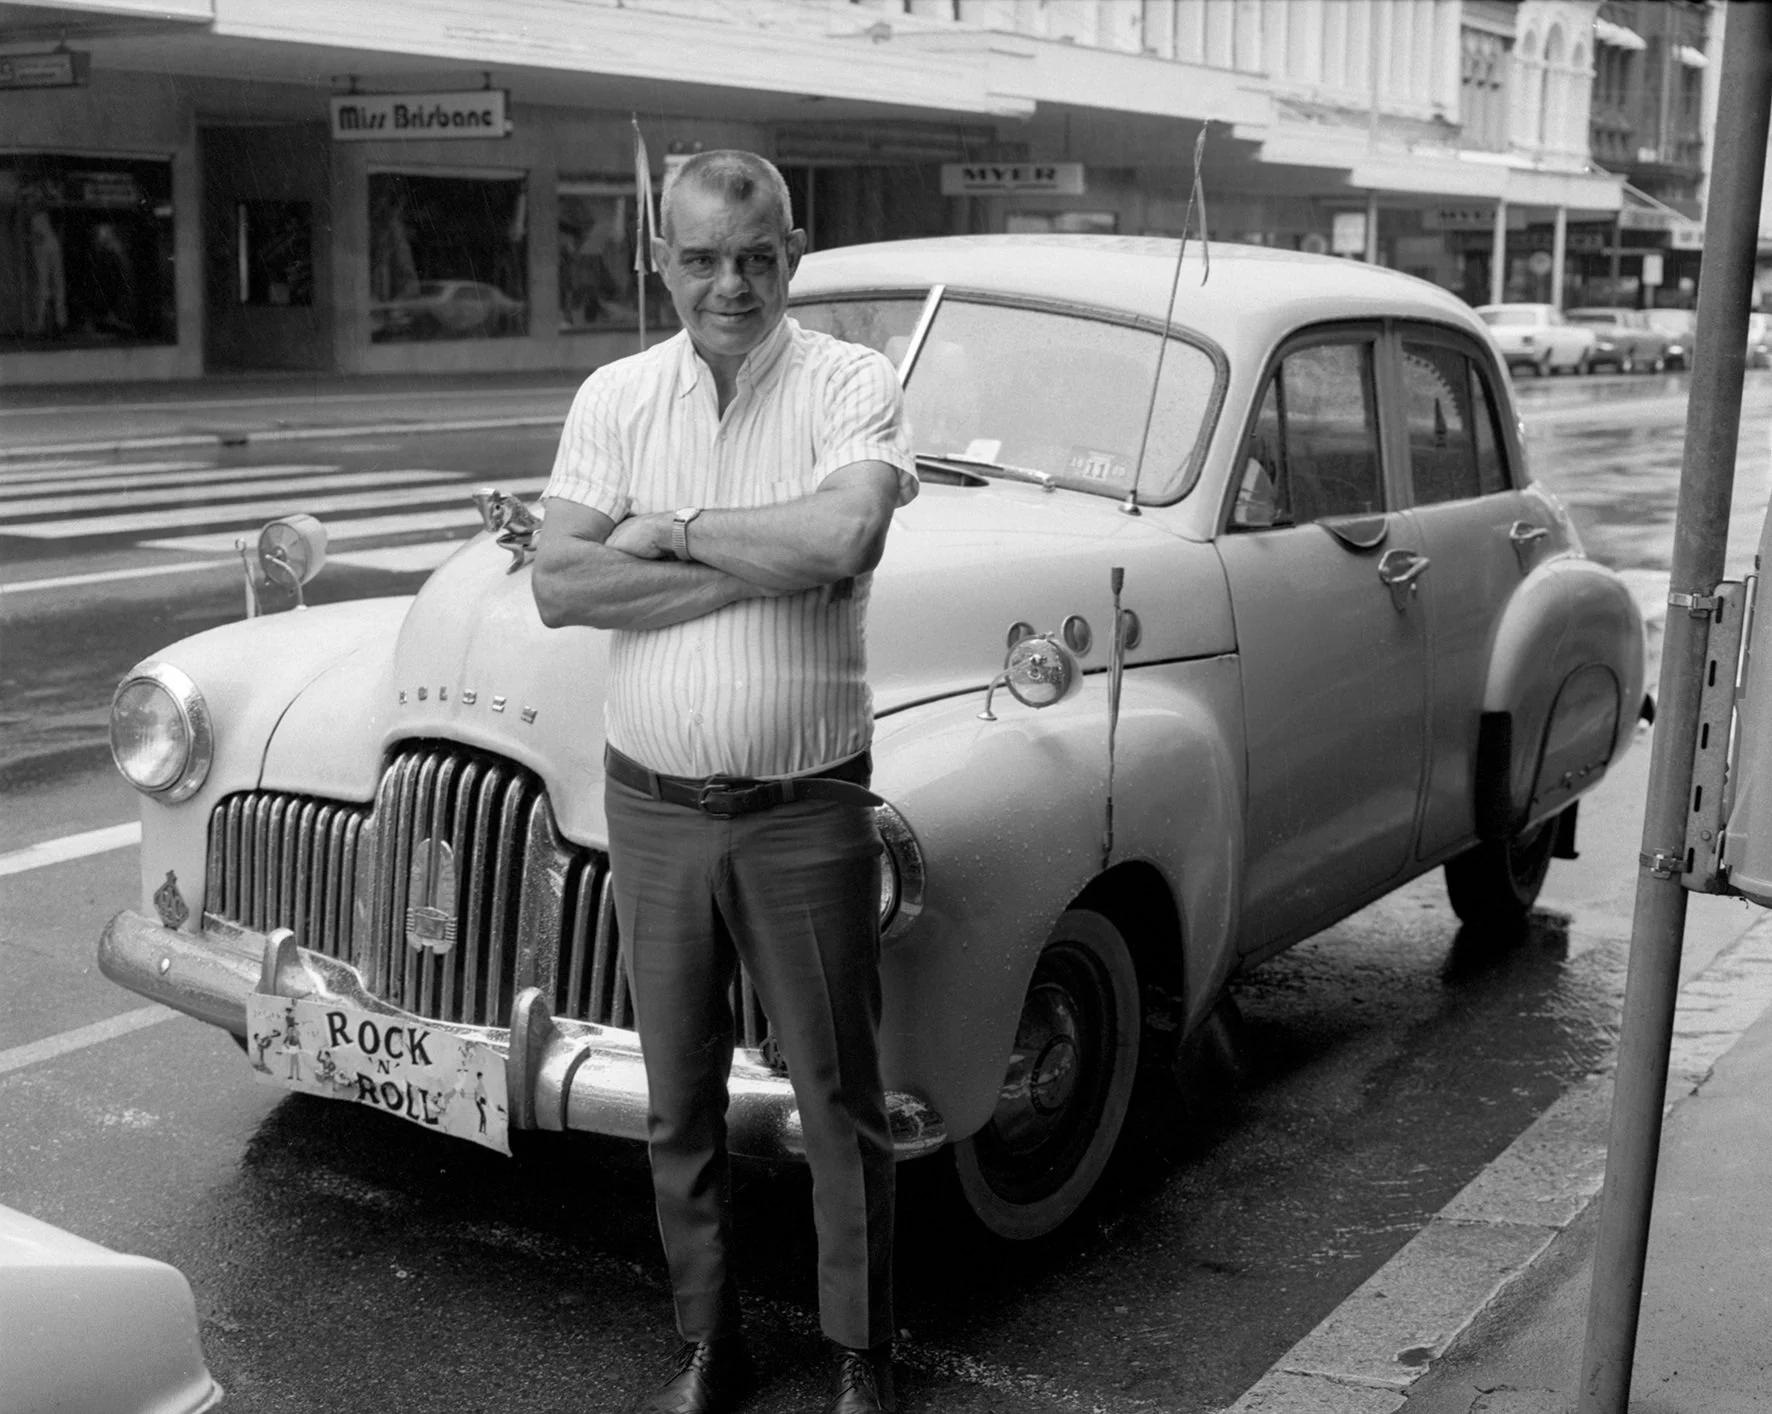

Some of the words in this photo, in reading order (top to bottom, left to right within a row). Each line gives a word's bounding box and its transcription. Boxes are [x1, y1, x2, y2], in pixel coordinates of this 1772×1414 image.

[339, 104, 387, 130] Miss
[394, 103, 492, 129] Brisbane
[962, 167, 1056, 181] MYER
[325, 1011, 433, 1066] ROCK
[356, 1072, 440, 1125] ROLL
